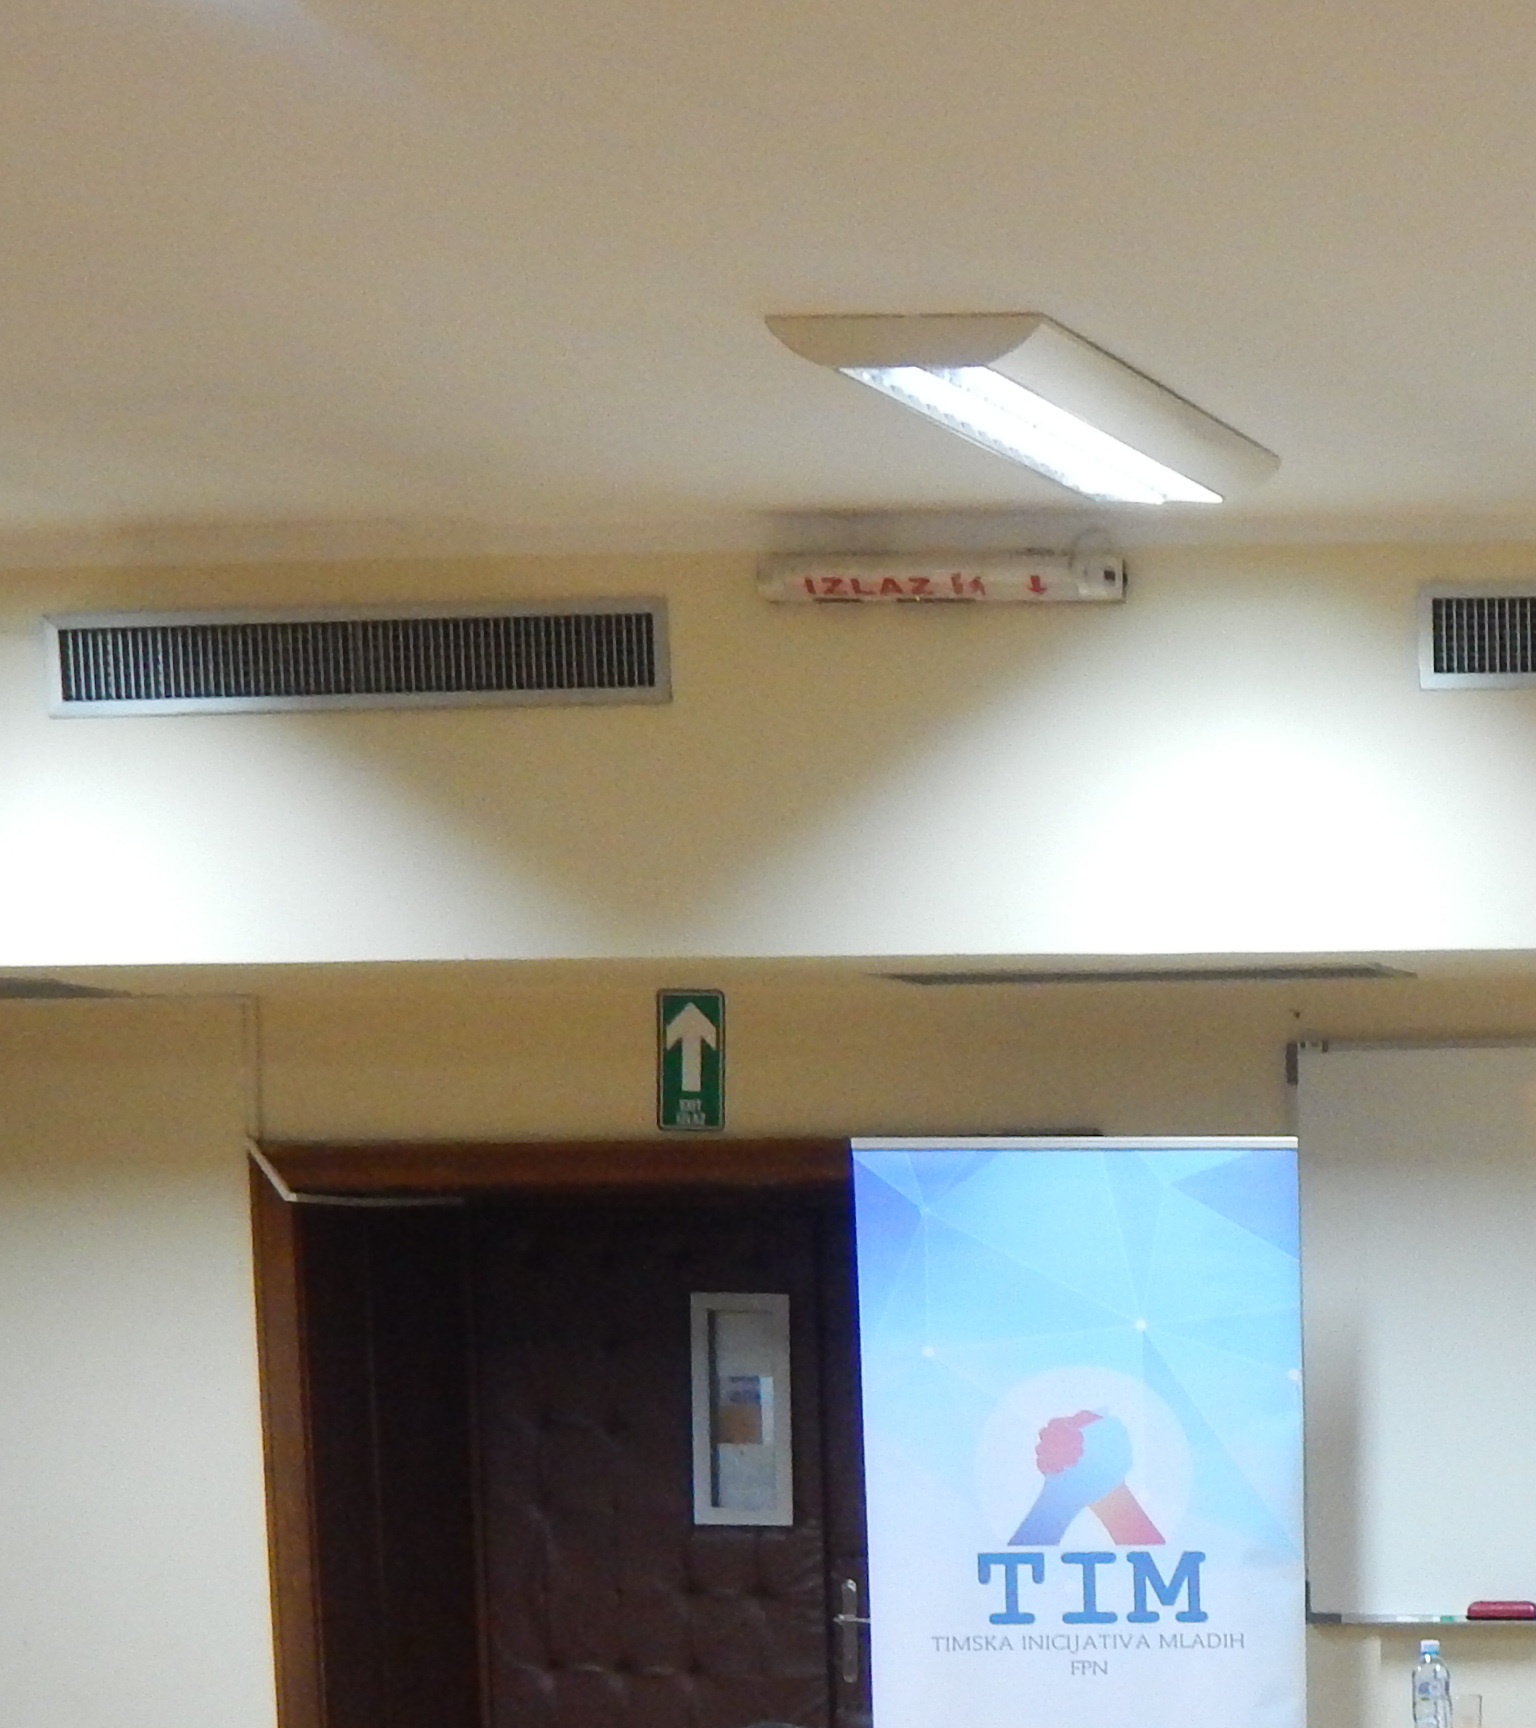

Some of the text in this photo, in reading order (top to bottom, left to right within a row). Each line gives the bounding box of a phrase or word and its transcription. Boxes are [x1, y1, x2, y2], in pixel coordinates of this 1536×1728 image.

[804, 577, 932, 595] IZLAZ
[977, 1551, 1209, 1624] TIM
[931, 1633, 1245, 1654] TIMSKA INICIJATIVA MLADIH
[1070, 1660, 1108, 1676] FPN
